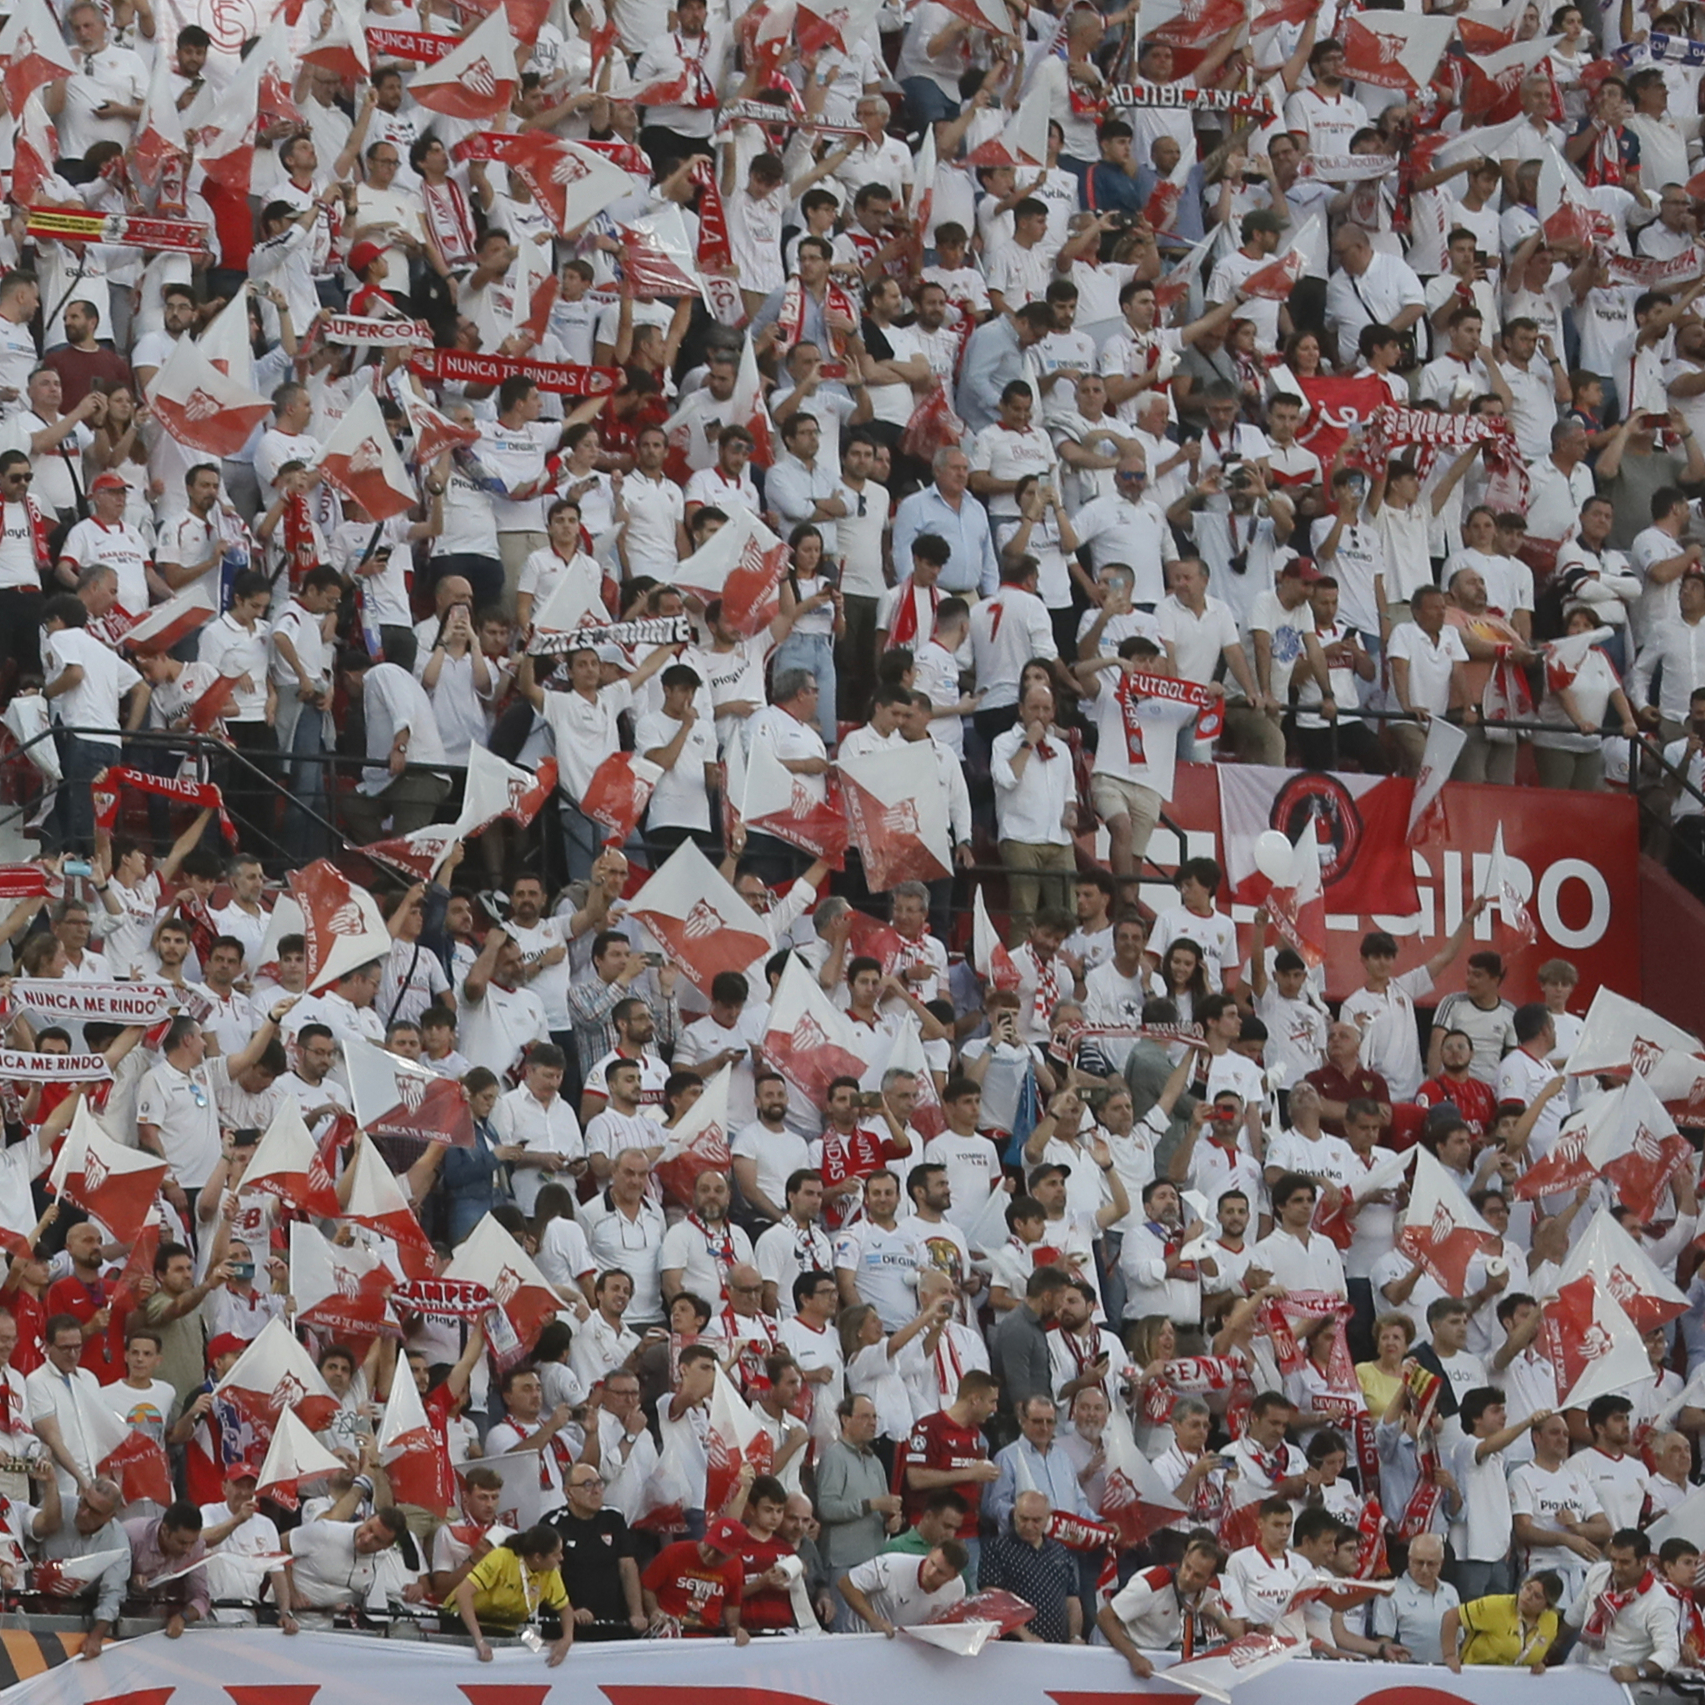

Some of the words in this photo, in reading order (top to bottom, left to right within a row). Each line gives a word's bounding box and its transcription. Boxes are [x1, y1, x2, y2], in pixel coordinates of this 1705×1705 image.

[418, 39, 434, 54] TE
[447, 355, 497, 378] NUNCA
[523, 366, 576, 387] RINDAS
[24, 990, 79, 1010] NUNCA
[82, 997, 106, 1012] ME
[110, 997, 157, 1015] RINDO
[31, 1056, 54, 1070] ME
[57, 1057, 104, 1071] RINDO
